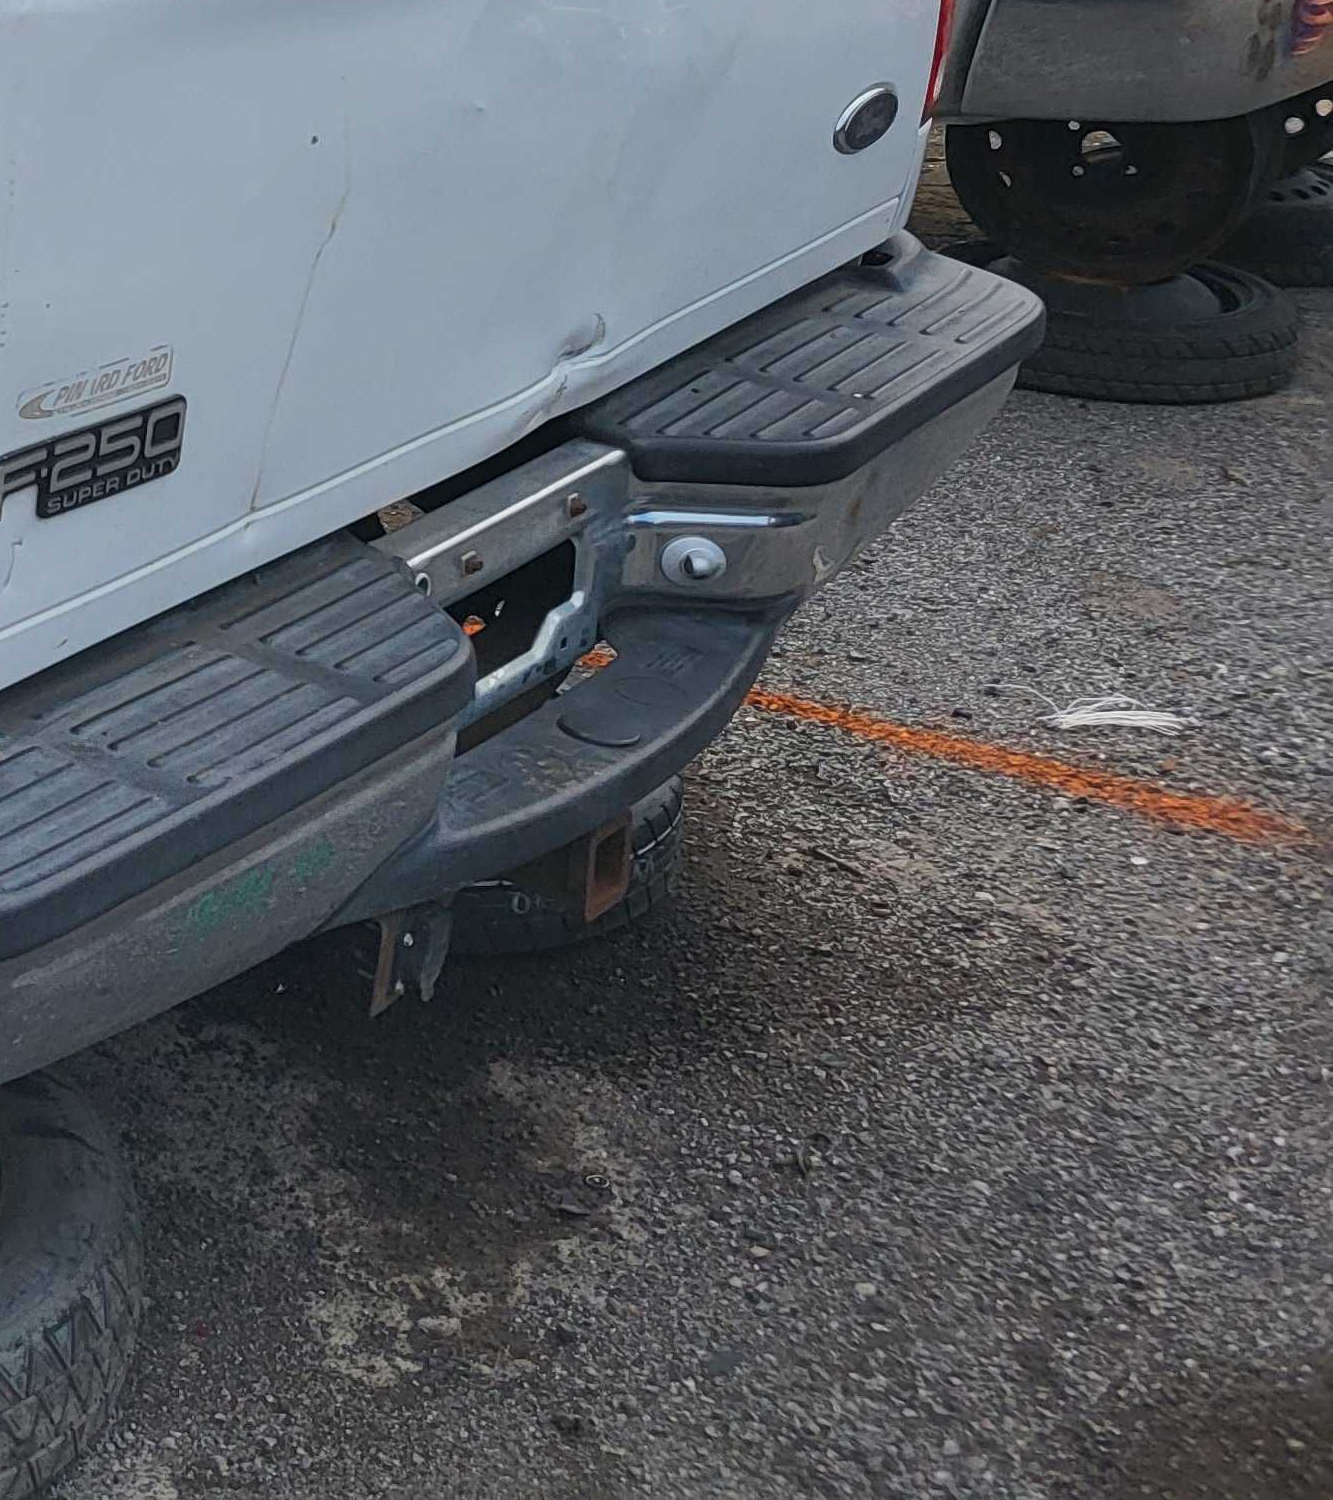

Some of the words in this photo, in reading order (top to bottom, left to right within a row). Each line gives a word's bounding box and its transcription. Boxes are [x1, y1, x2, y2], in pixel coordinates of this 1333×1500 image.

[120, 352, 170, 386] FORD
[45, 474, 121, 516] SUPER
[125, 454, 179, 487] DUTY
